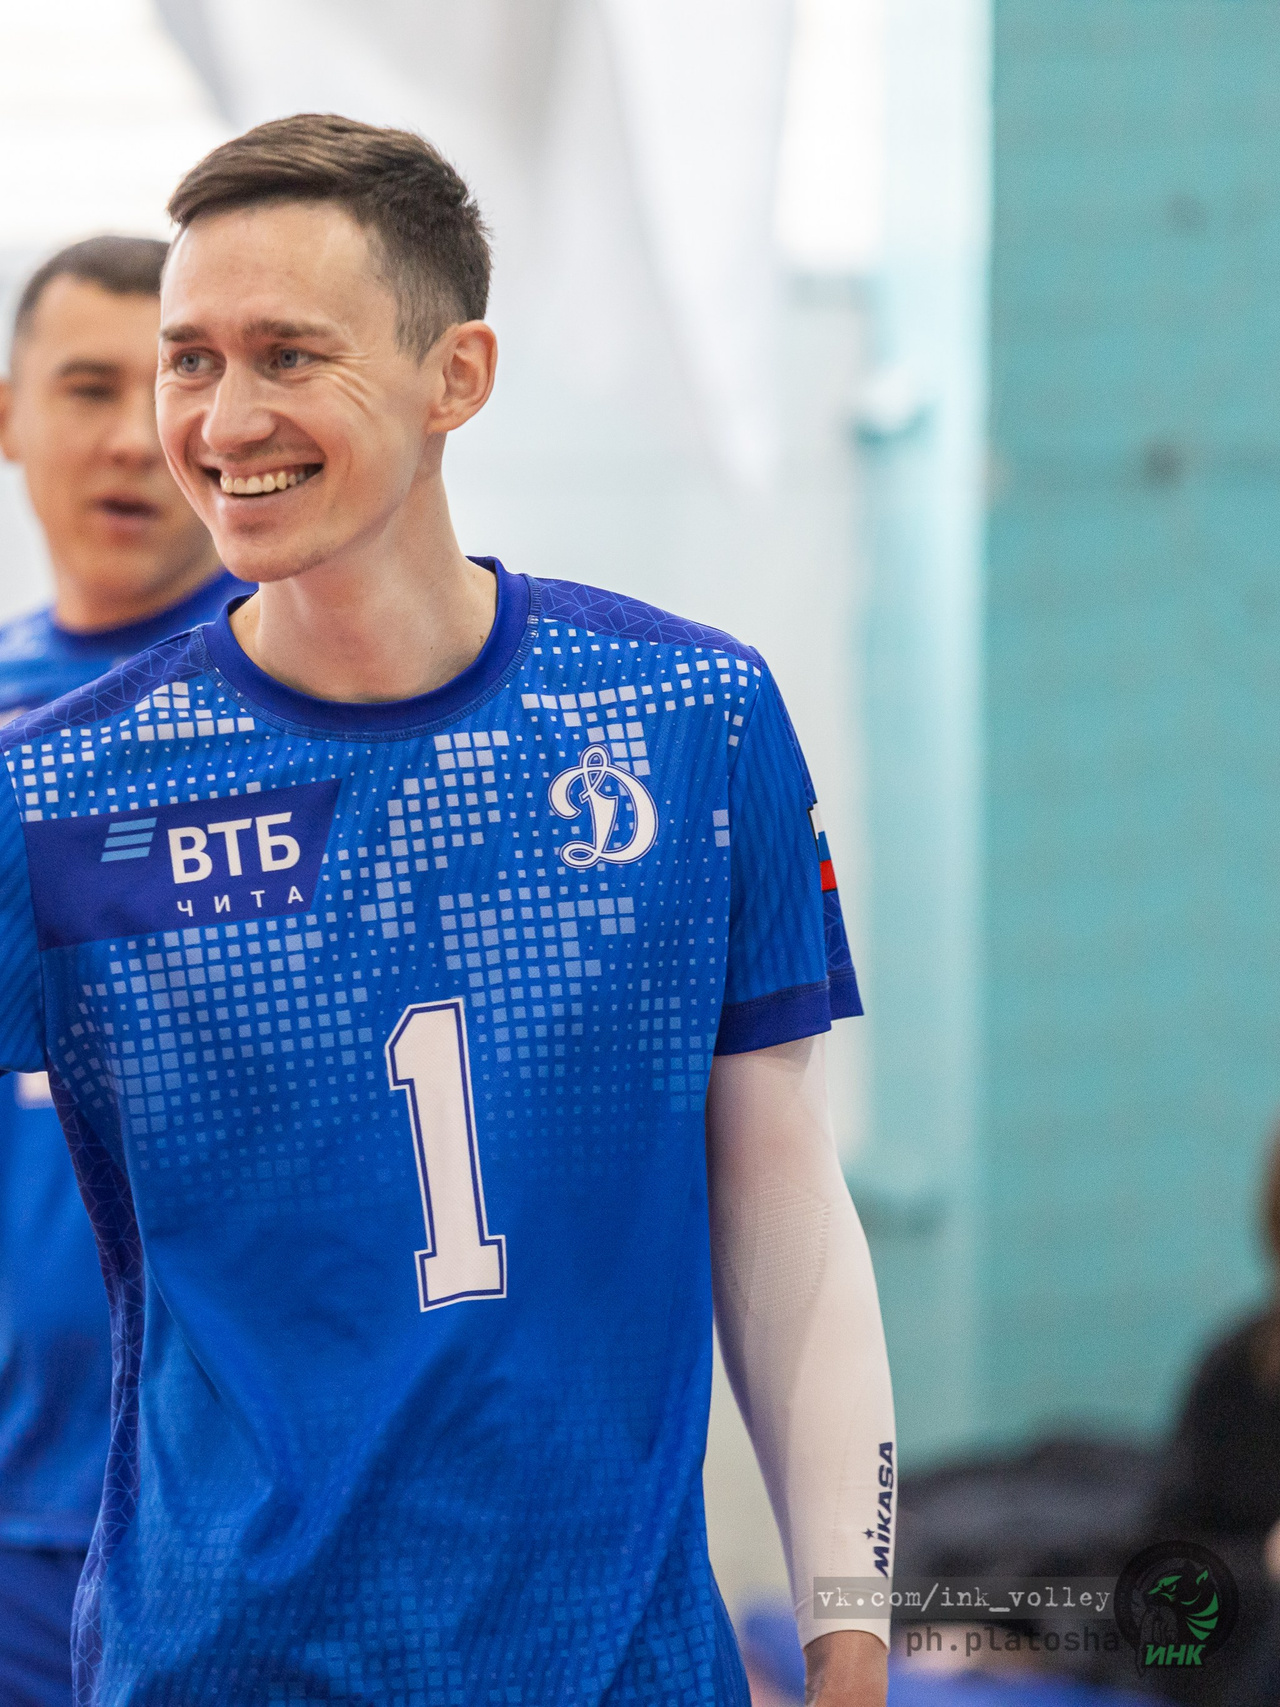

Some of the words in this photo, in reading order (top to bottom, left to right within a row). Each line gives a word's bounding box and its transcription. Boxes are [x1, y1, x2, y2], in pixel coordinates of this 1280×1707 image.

[167, 811, 301, 884] ВТБ
[177, 885, 304, 917] ЧИТА
[384, 998, 507, 1312] 1
